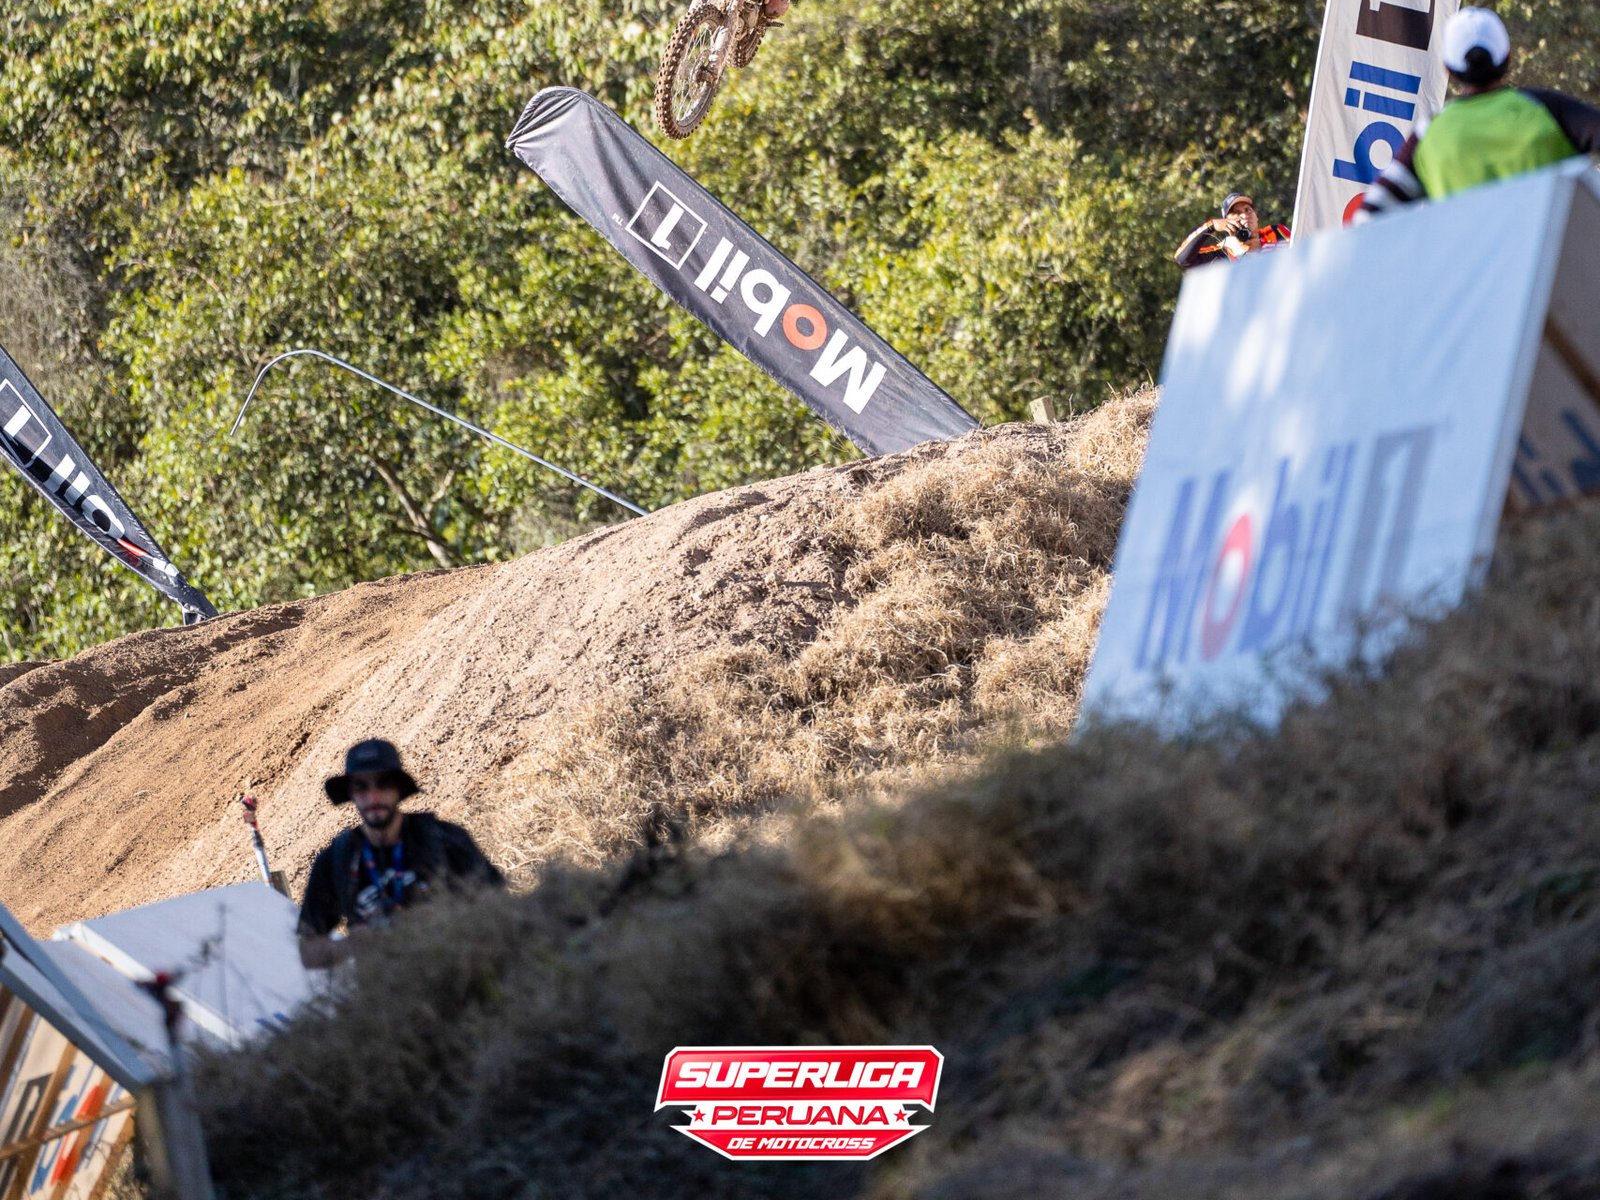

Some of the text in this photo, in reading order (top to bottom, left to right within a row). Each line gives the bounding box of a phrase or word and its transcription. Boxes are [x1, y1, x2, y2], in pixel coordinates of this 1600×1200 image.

[1333, 61, 1421, 225] bil
[694, 237, 887, 415] Mobil
[1133, 438, 1357, 670] Mobil
